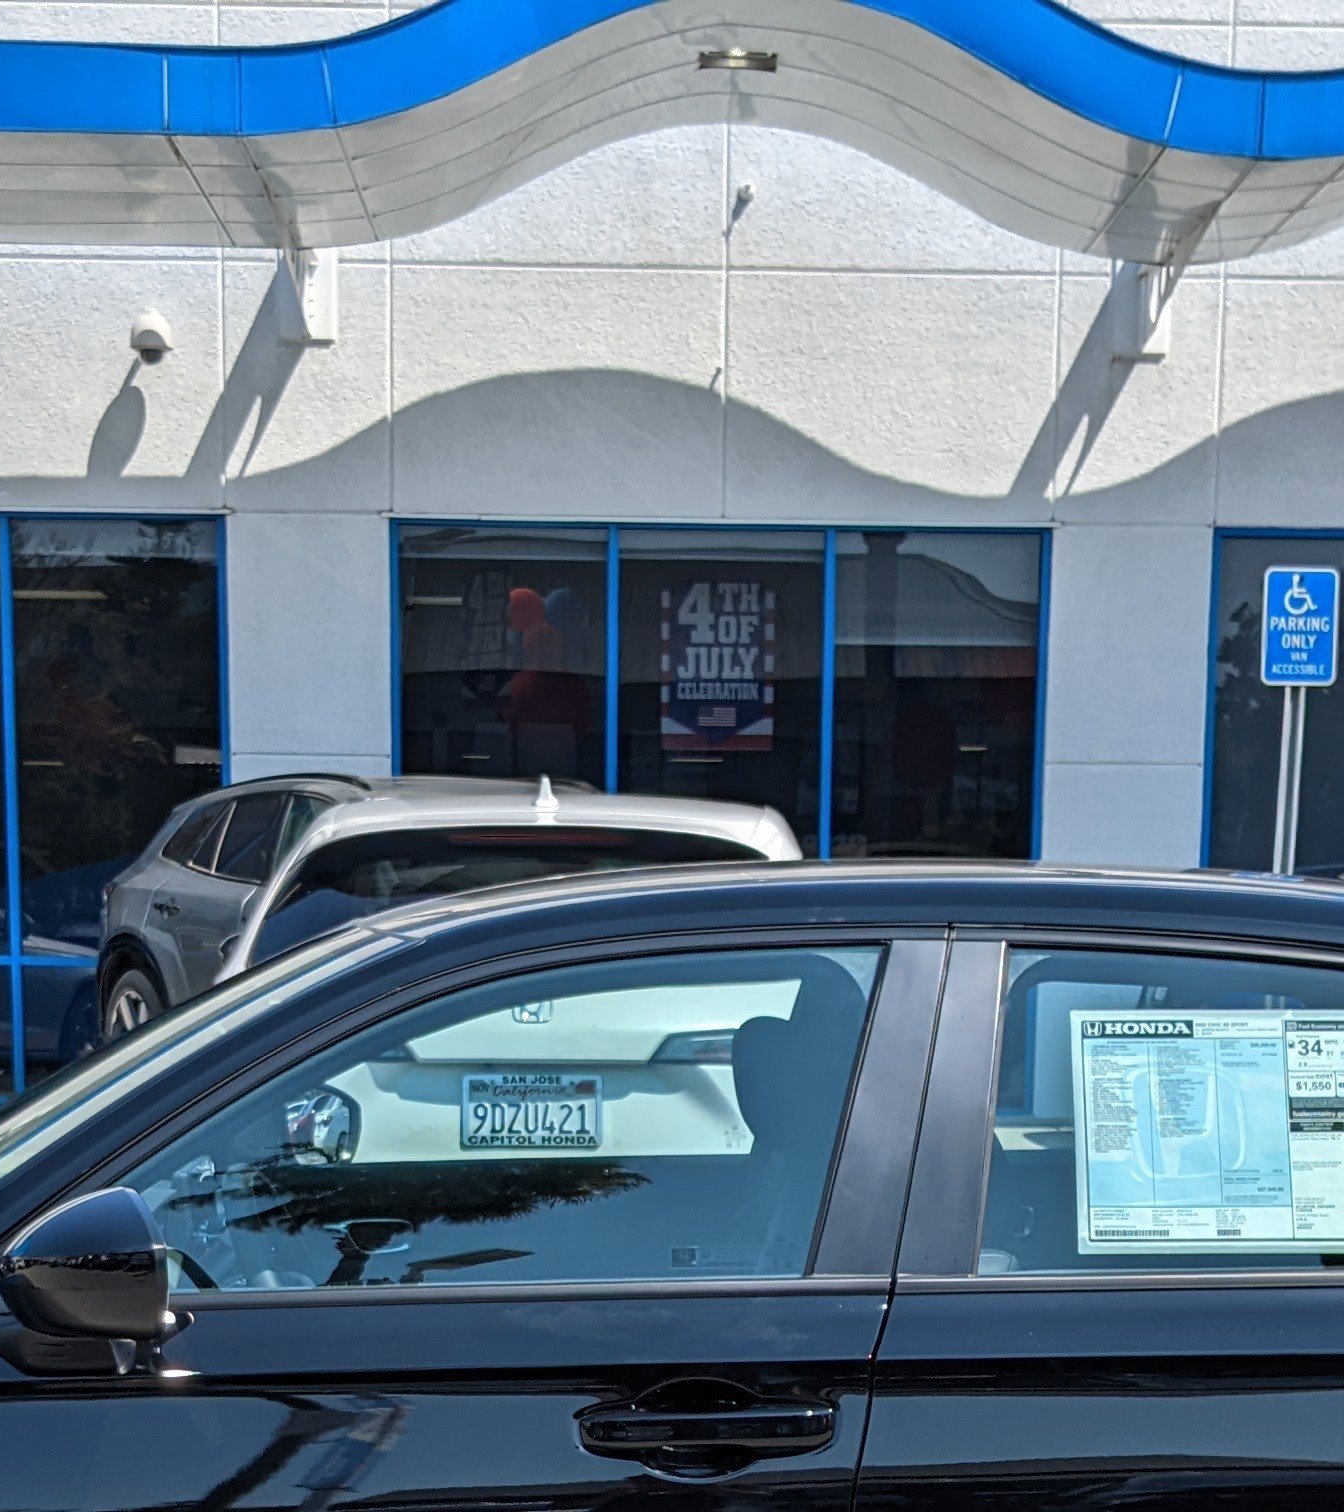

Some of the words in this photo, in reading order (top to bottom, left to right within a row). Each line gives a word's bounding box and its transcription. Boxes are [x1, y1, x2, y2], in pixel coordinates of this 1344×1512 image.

[717, 615, 760, 645] OF
[1269, 616, 1330, 632] PARKING
[1281, 634, 1317, 650] ONLY
[676, 646, 759, 680] JULY
[1290, 652, 1308, 662] VAN
[1271, 663, 1325, 676] ACCESSIBLE
[677, 682, 759, 700] CELEBRATION
[1103, 1022, 1192, 1035] HONDA
[1297, 1039, 1323, 1057] 34
[502, 1075, 527, 1085] SAN
[530, 1075, 563, 1085] JOSE
[1295, 1081, 1332, 1091] $1,550
[473, 1103, 591, 1135] 9DZU421
[467, 1135, 537, 1145] CAPITOL
[541, 1135, 597, 1145] HONDA
